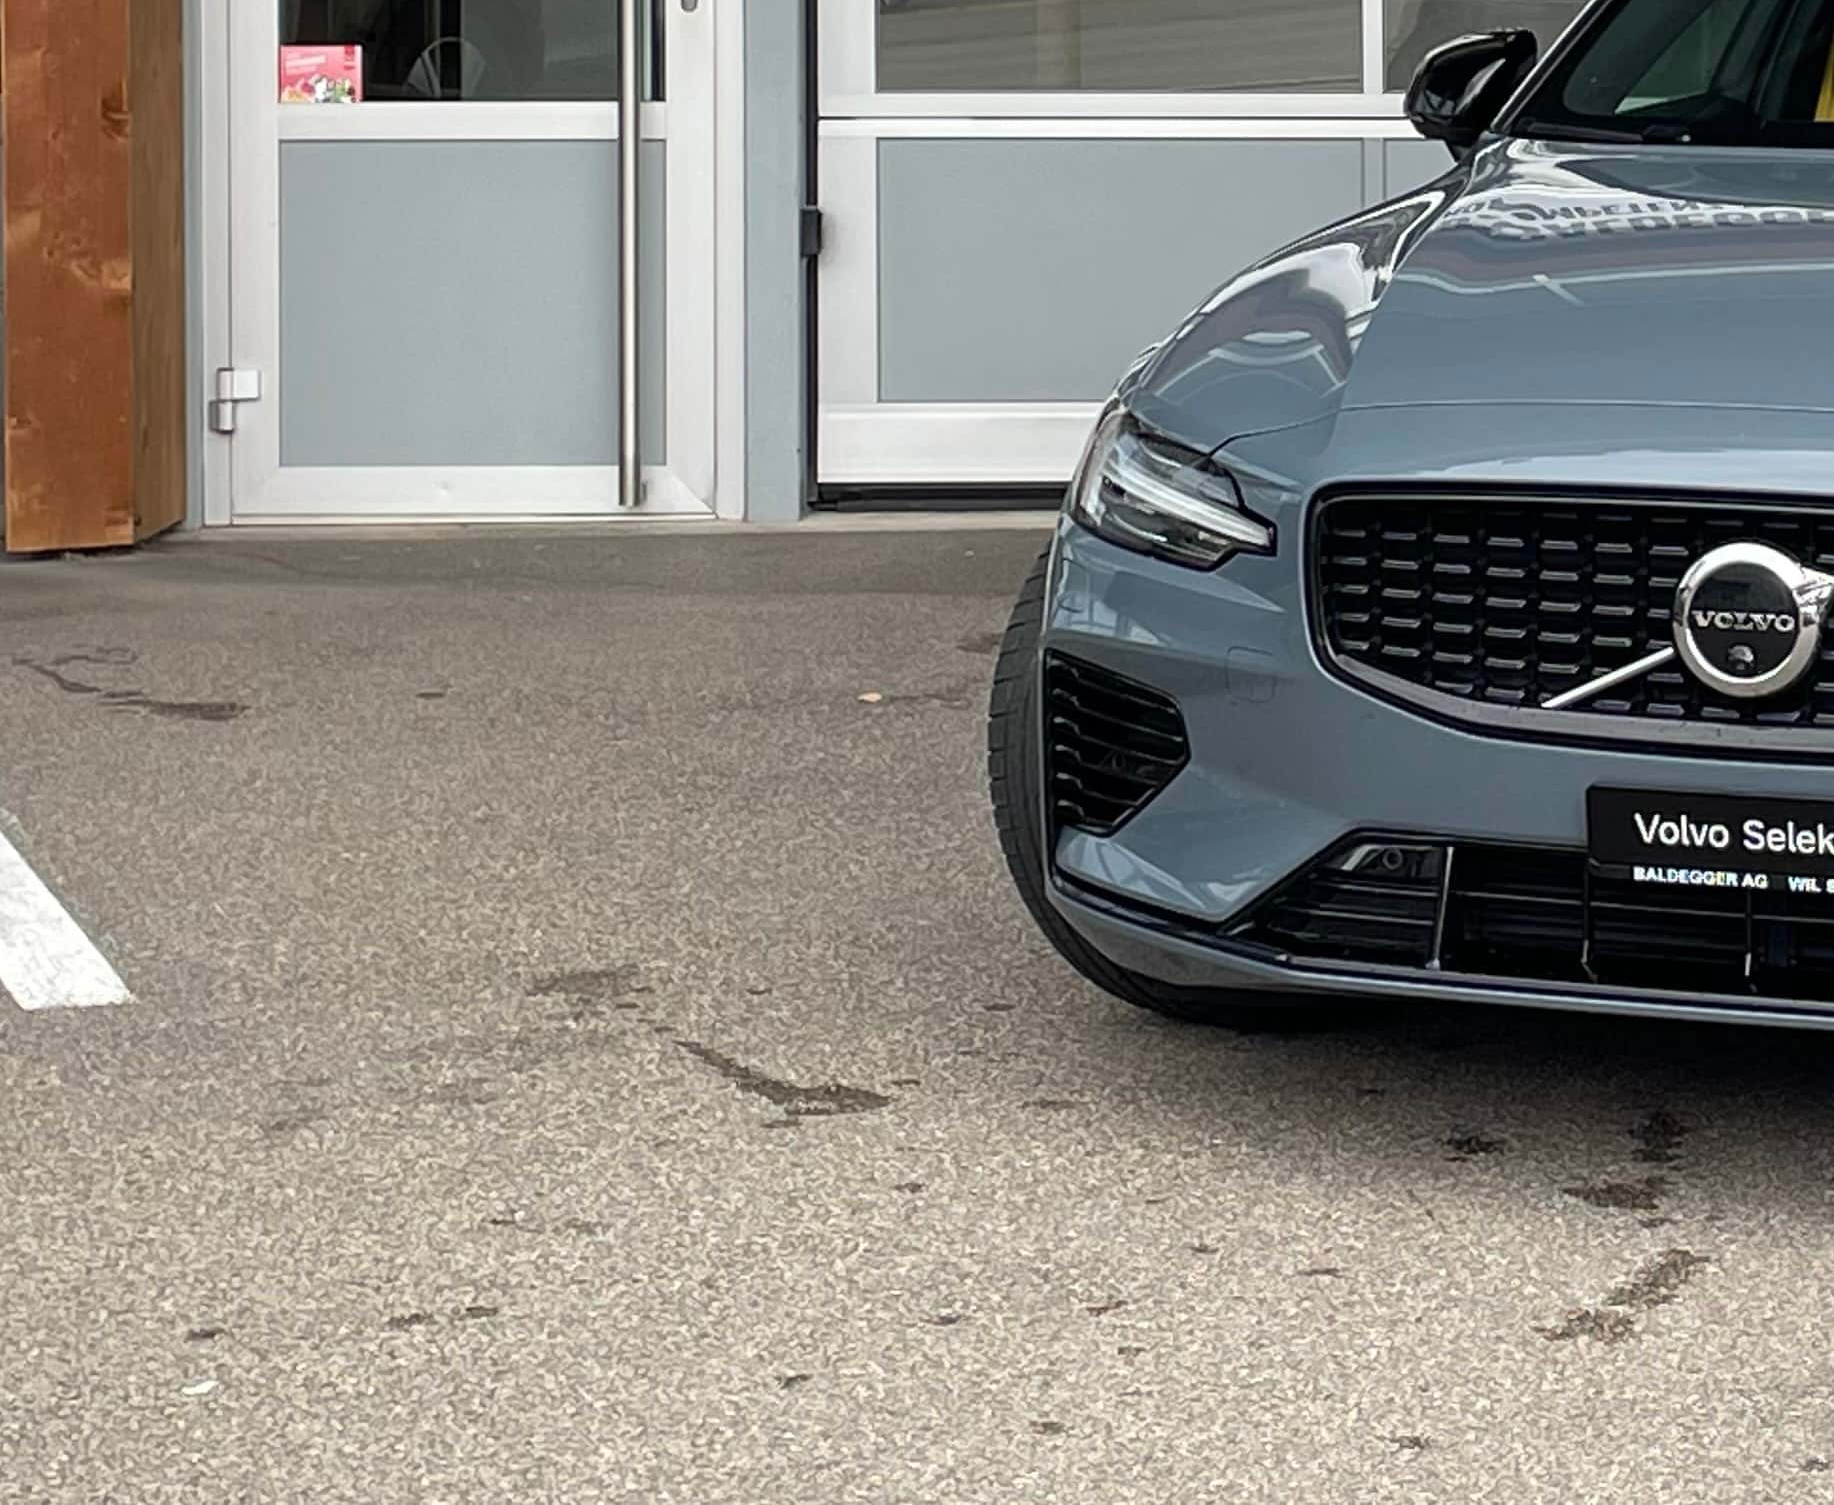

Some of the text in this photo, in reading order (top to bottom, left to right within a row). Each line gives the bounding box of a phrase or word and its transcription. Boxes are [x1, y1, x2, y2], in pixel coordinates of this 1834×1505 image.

[1691, 610, 1795, 633] VOLVO
[1634, 812, 1730, 848] Volvo
[1633, 866, 1739, 888] BALDEGGER
[1741, 872, 1769, 890] AG
